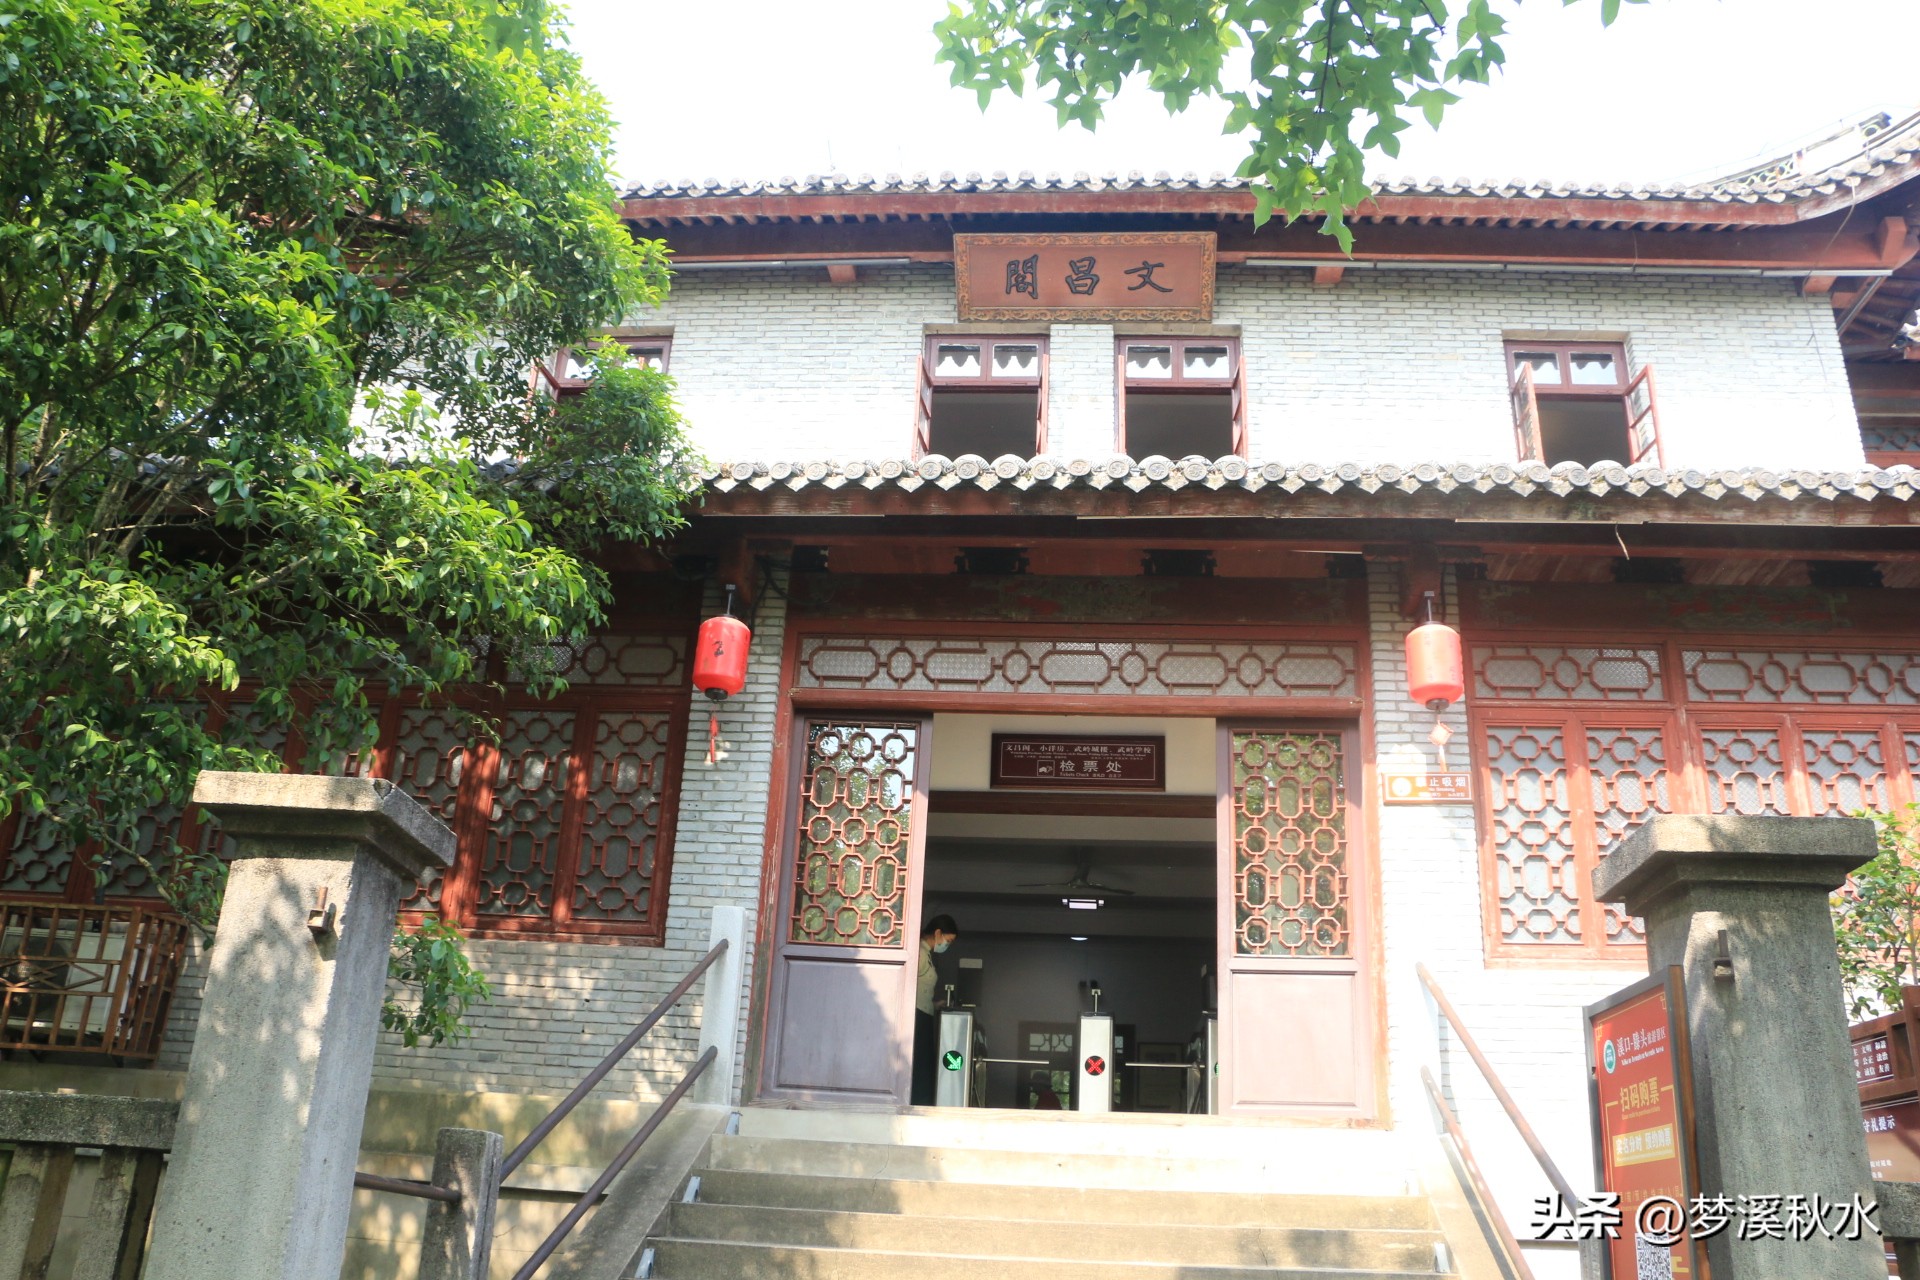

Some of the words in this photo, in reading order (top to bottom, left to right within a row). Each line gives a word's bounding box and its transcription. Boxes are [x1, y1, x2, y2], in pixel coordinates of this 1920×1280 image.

[1060, 760, 1122, 773] 检票处
[1620, 1077, 1660, 1112] 扫码购票
